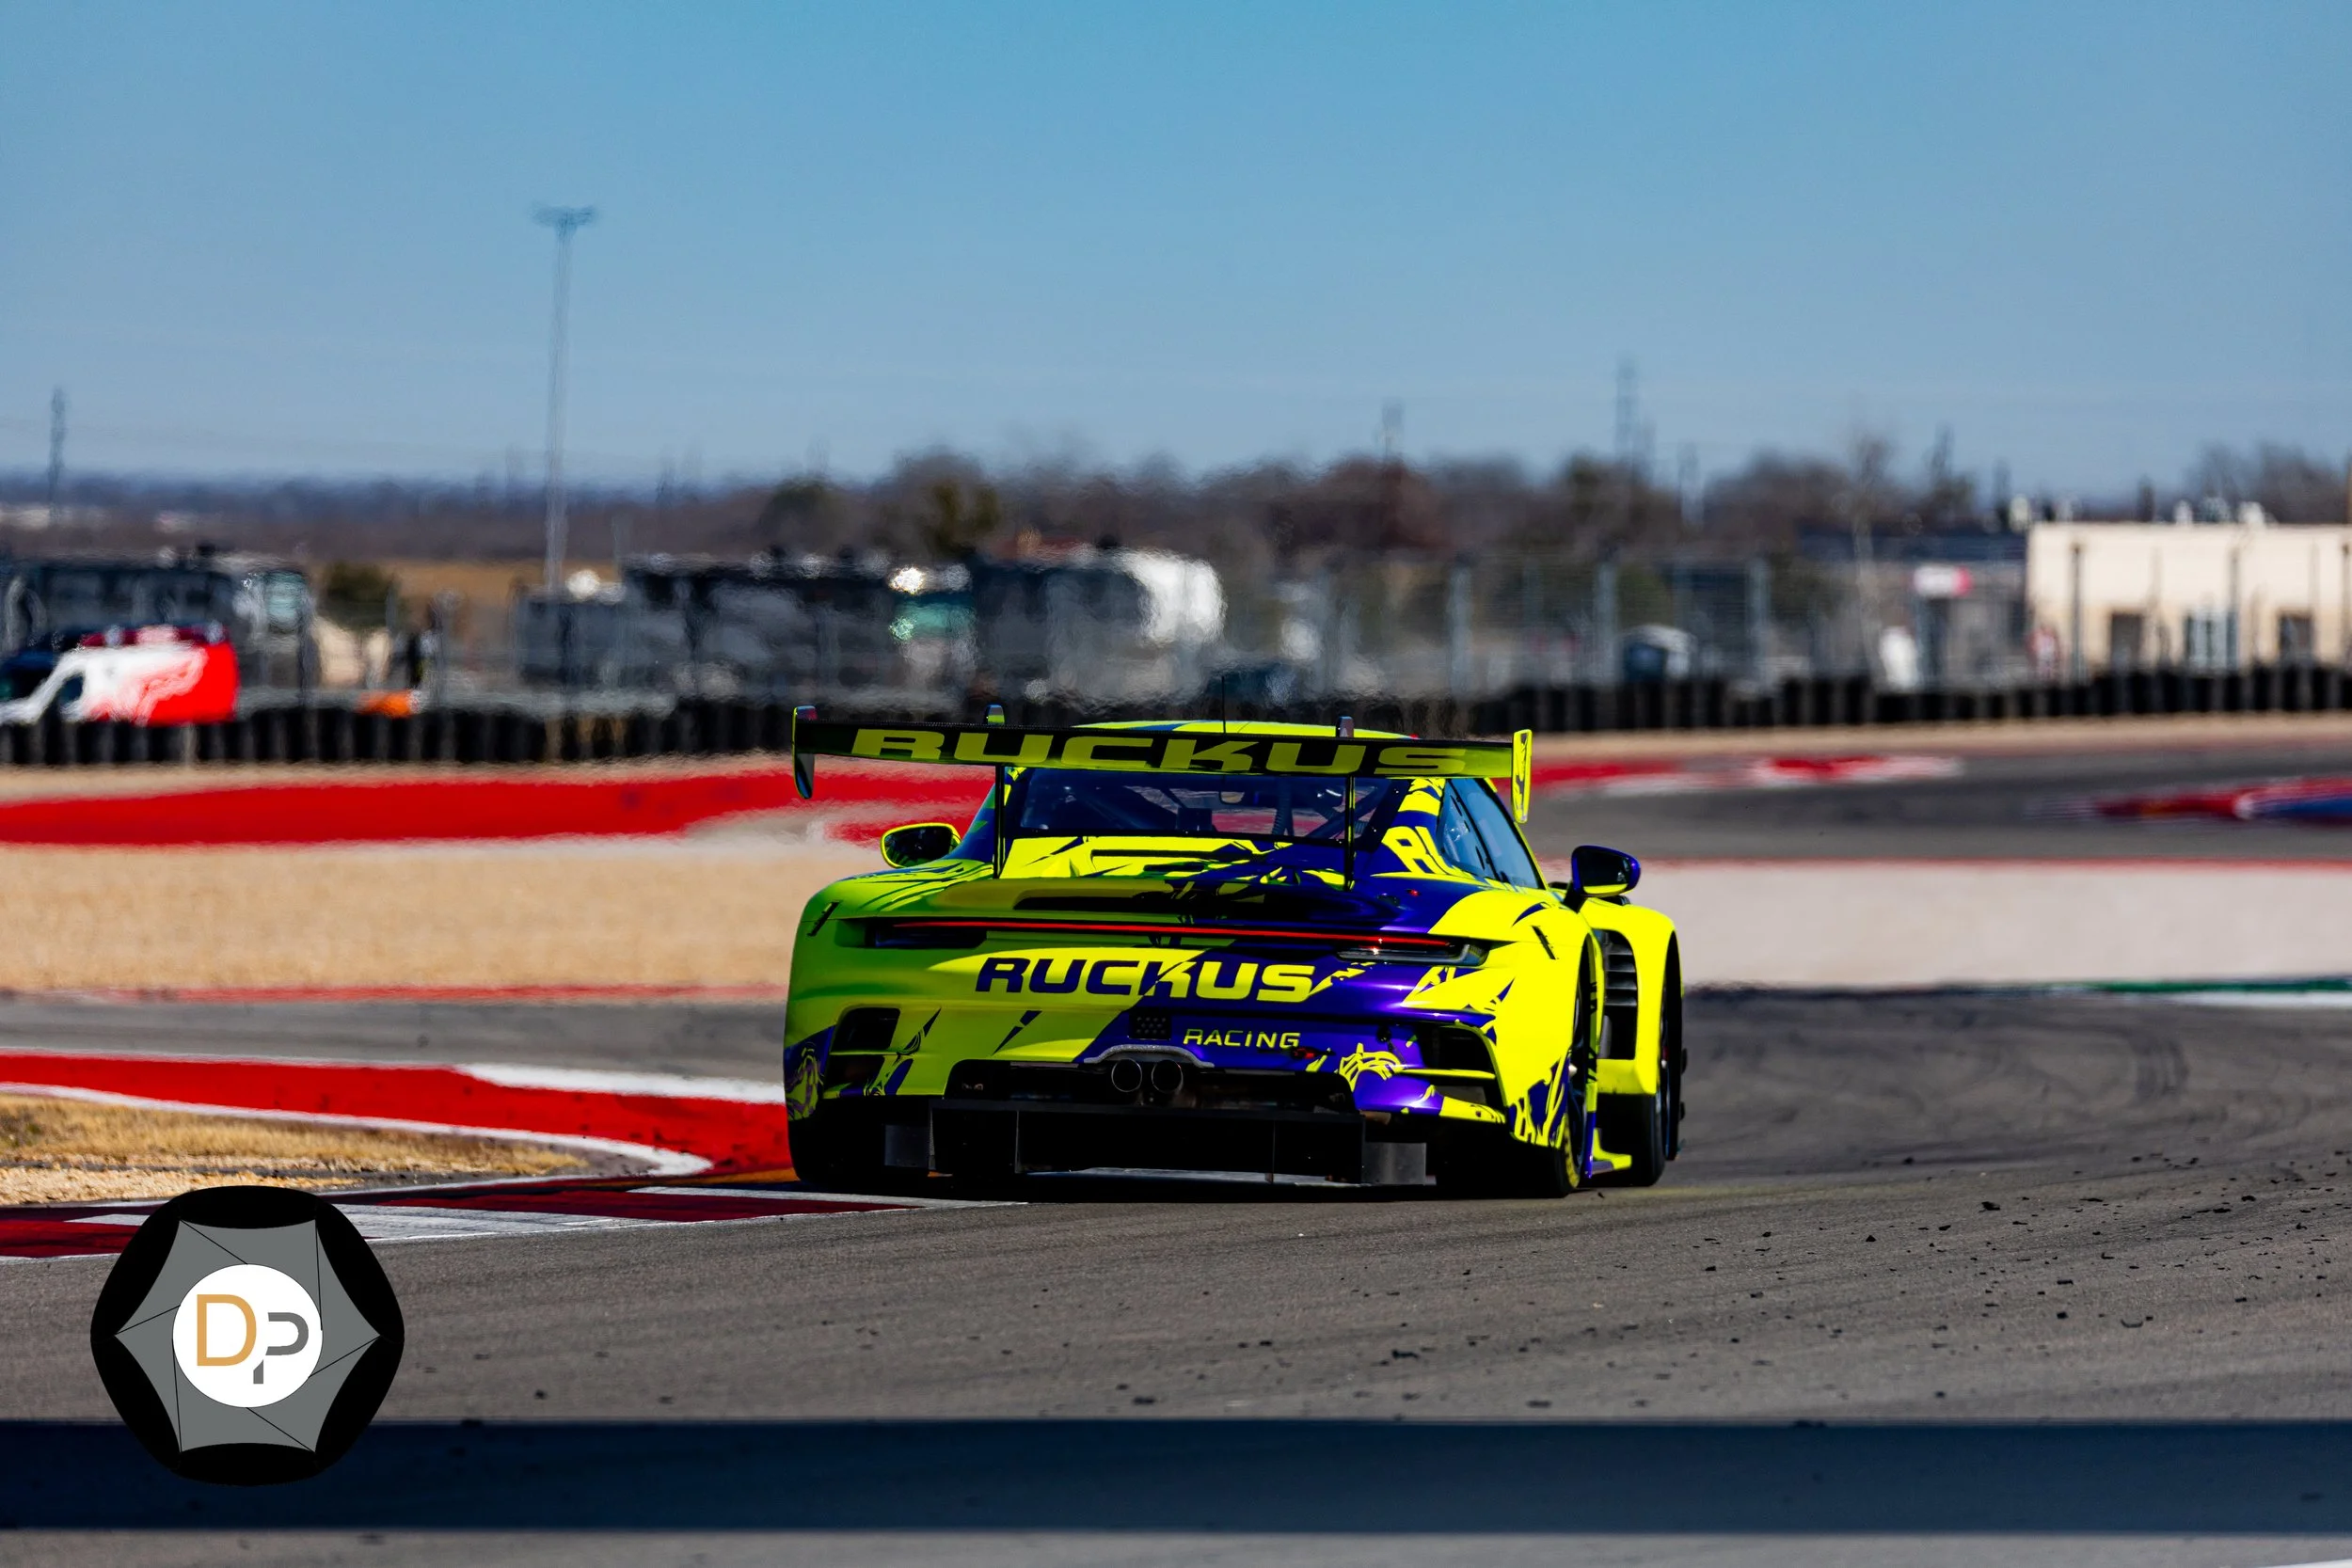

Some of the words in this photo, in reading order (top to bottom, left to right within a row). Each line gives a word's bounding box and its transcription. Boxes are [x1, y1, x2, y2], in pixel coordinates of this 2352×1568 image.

[851, 728, 1467, 775] RUCKUS
[975, 957, 1317, 1004] RUCKUS
[1183, 1028, 1301, 1049] RACING
